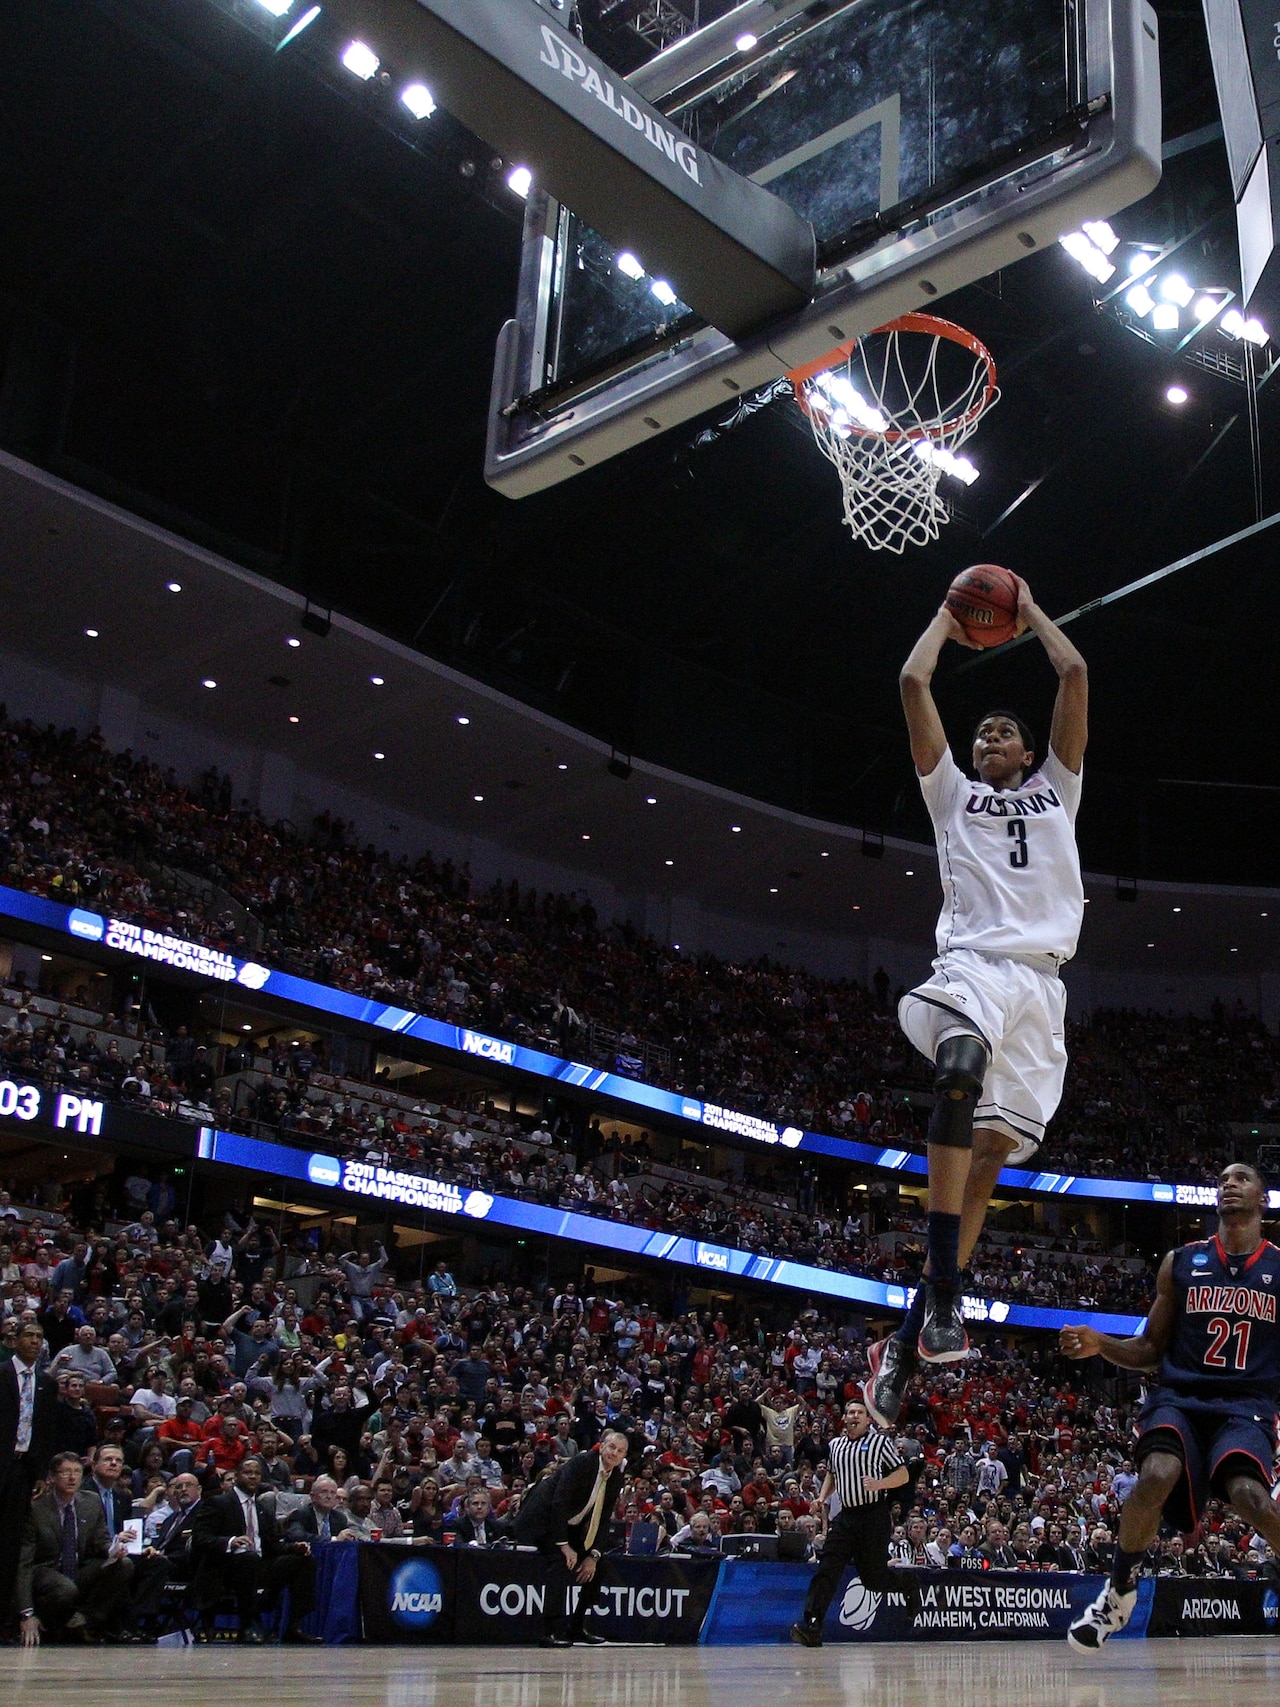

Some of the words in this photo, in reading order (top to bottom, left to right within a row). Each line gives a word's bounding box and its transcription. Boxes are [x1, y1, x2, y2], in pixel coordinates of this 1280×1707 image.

[540, 25, 700, 184] SPALDING
[965, 788, 1060, 816] UCONN
[1007, 818, 1028, 868] 3
[106, 932, 236, 982] CHAMPIONSHIP
[108, 919, 141, 937] 2011
[143, 929, 236, 968] BASKETBALL
[463, 1033, 513, 1063] NCAA
[57, 1093, 104, 1136] PM
[703, 1113, 779, 1144] CHAMPIONSHIP
[343, 1175, 463, 1214] CHAMPIONSHIP
[344, 1160, 375, 1180] 2011
[376, 1167, 462, 1199] BASKETBALL
[697, 1249, 727, 1269] NCAA
[1186, 1286, 1277, 1323] ARIZONA
[1203, 1317, 1252, 1370] 21
[960, 1557, 982, 1570] POSS
[391, 1593, 442, 1613] NCAA
[944, 1585, 990, 1608] WEST
[997, 1587, 1071, 1609] REGIONAL
[1182, 1598, 1241, 1620] ARIZONA
[913, 1611, 977, 1630] ANAHEIM,
[980, 1611, 1050, 1628] CALIFORNIA
